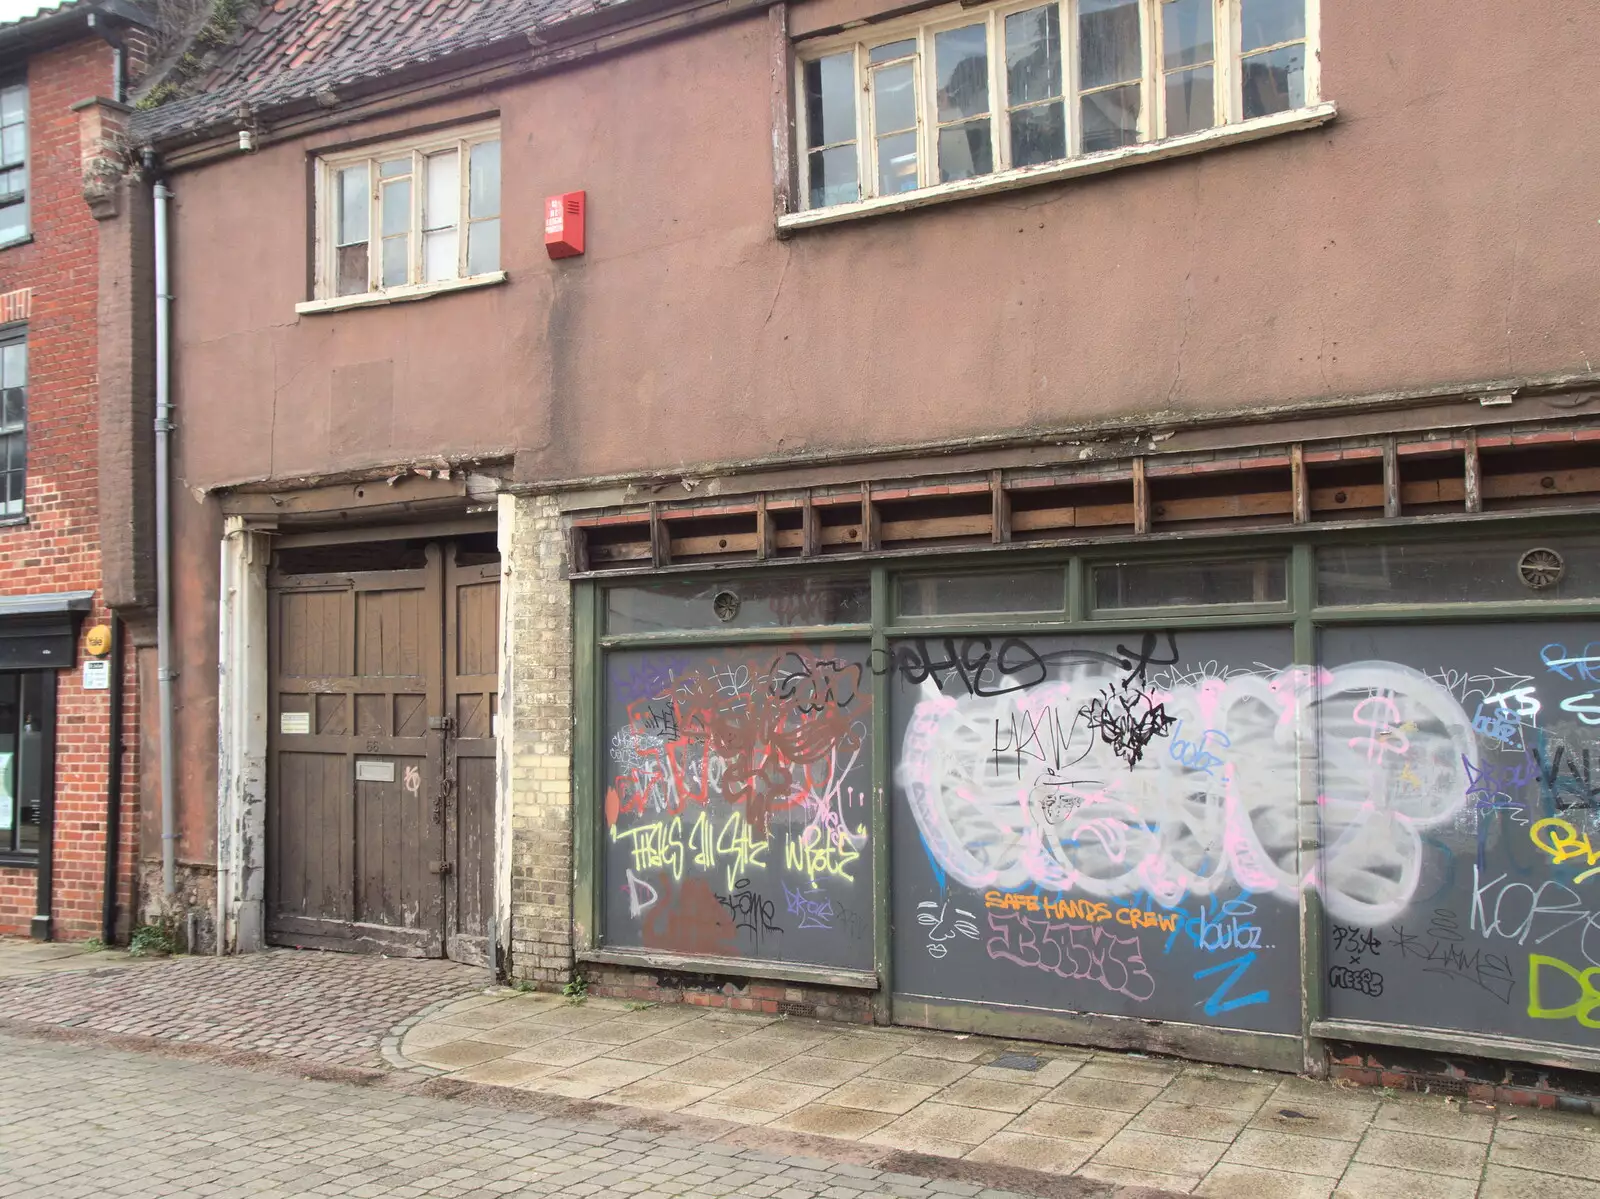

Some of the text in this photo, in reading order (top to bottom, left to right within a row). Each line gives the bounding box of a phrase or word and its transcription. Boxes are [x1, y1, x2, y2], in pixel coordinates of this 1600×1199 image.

[88, 637, 103, 646] Yale
[985, 891, 1179, 932] SAFE HANDS CREW
